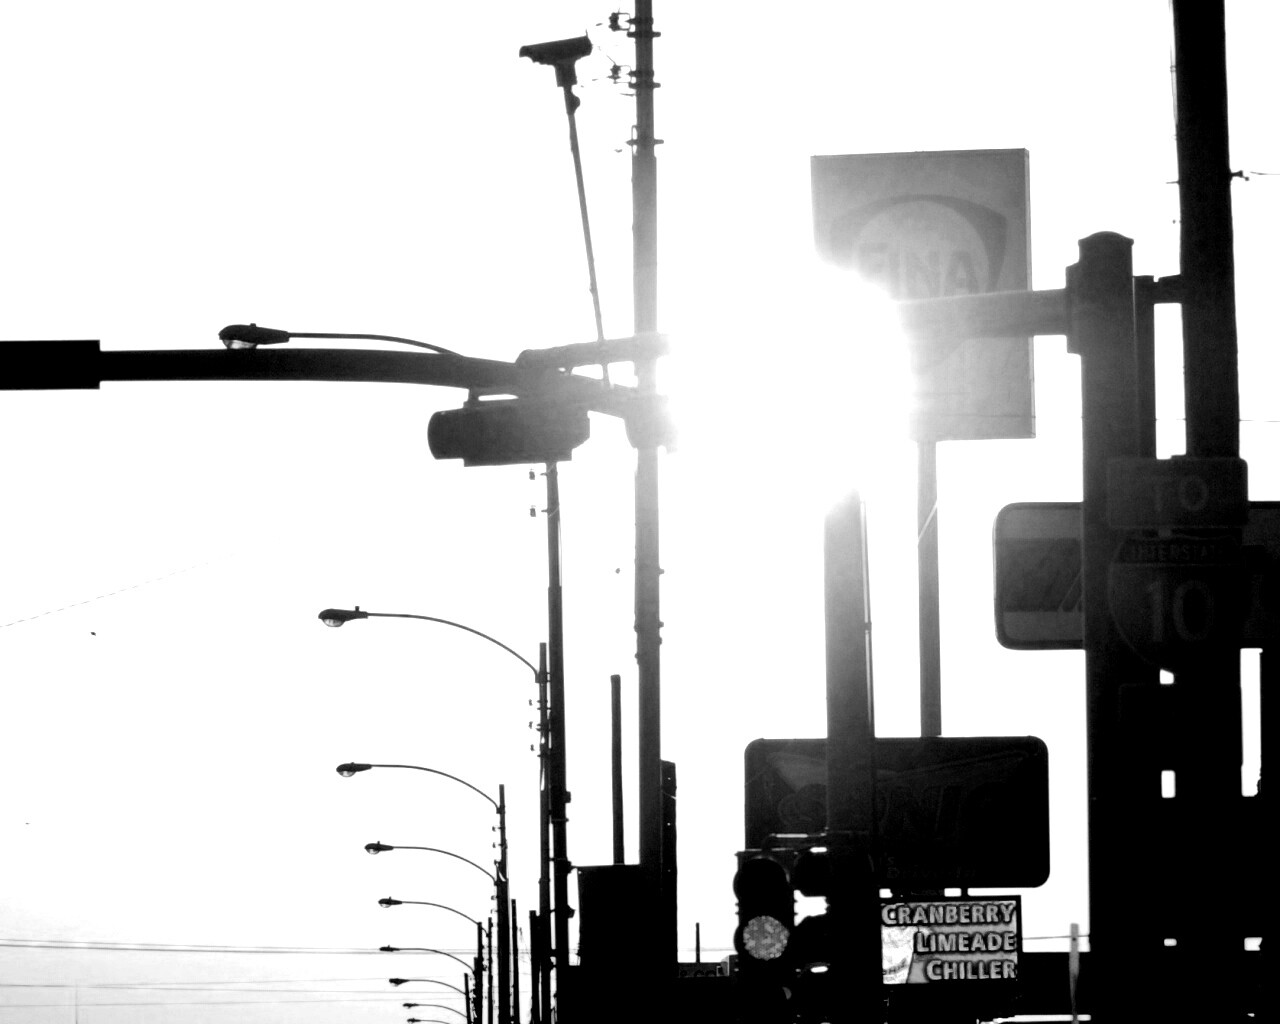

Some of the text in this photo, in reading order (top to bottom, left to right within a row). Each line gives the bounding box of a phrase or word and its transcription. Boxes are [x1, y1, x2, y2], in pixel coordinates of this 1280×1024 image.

[857, 243, 981, 299] FINA
[1144, 475, 1209, 512] TO
[1145, 577, 1215, 642] 10
[881, 903, 1014, 924] CRANBERRY
[916, 932, 1016, 952] LIMEADE
[926, 960, 1016, 980] CHILLER
